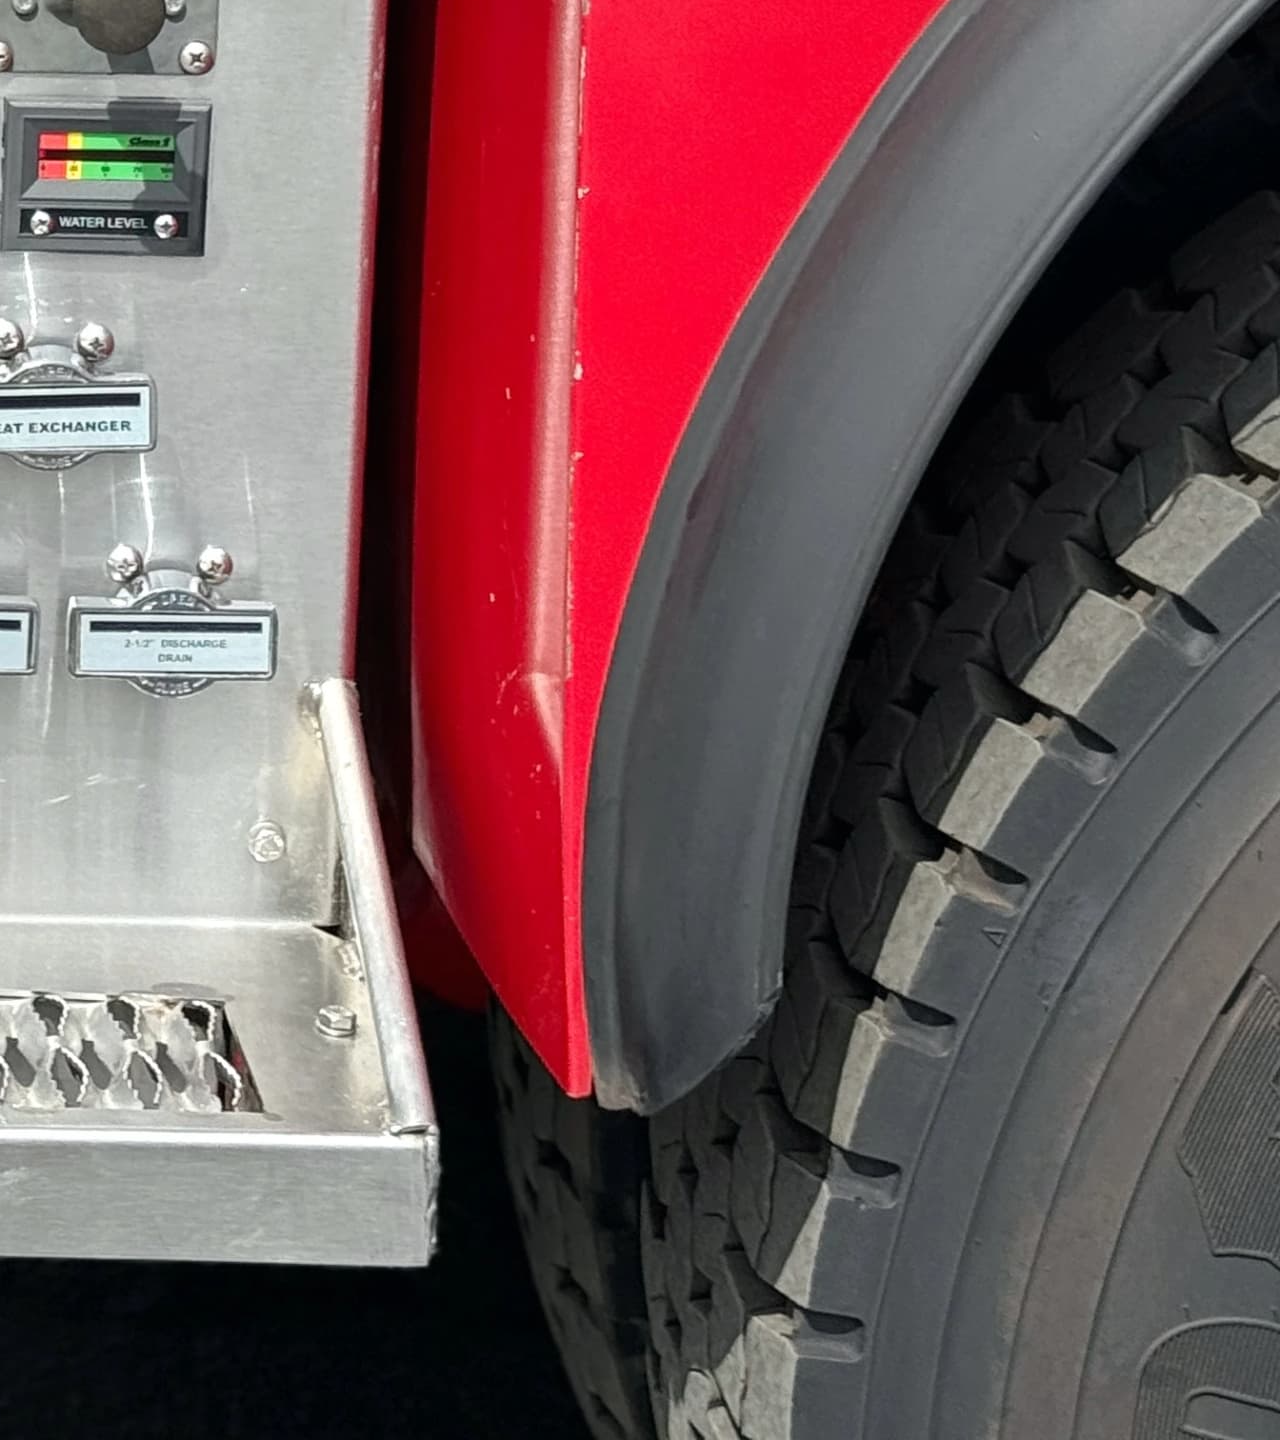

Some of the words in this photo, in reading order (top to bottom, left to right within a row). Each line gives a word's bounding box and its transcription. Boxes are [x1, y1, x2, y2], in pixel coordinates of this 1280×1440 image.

[59, 216, 105, 228] WATER
[107, 216, 148, 229] LEVEL
[28, 420, 132, 434] EXCHANGER
[160, 639, 228, 649] DISCHARGE
[157, 653, 193, 663] DRAIN
